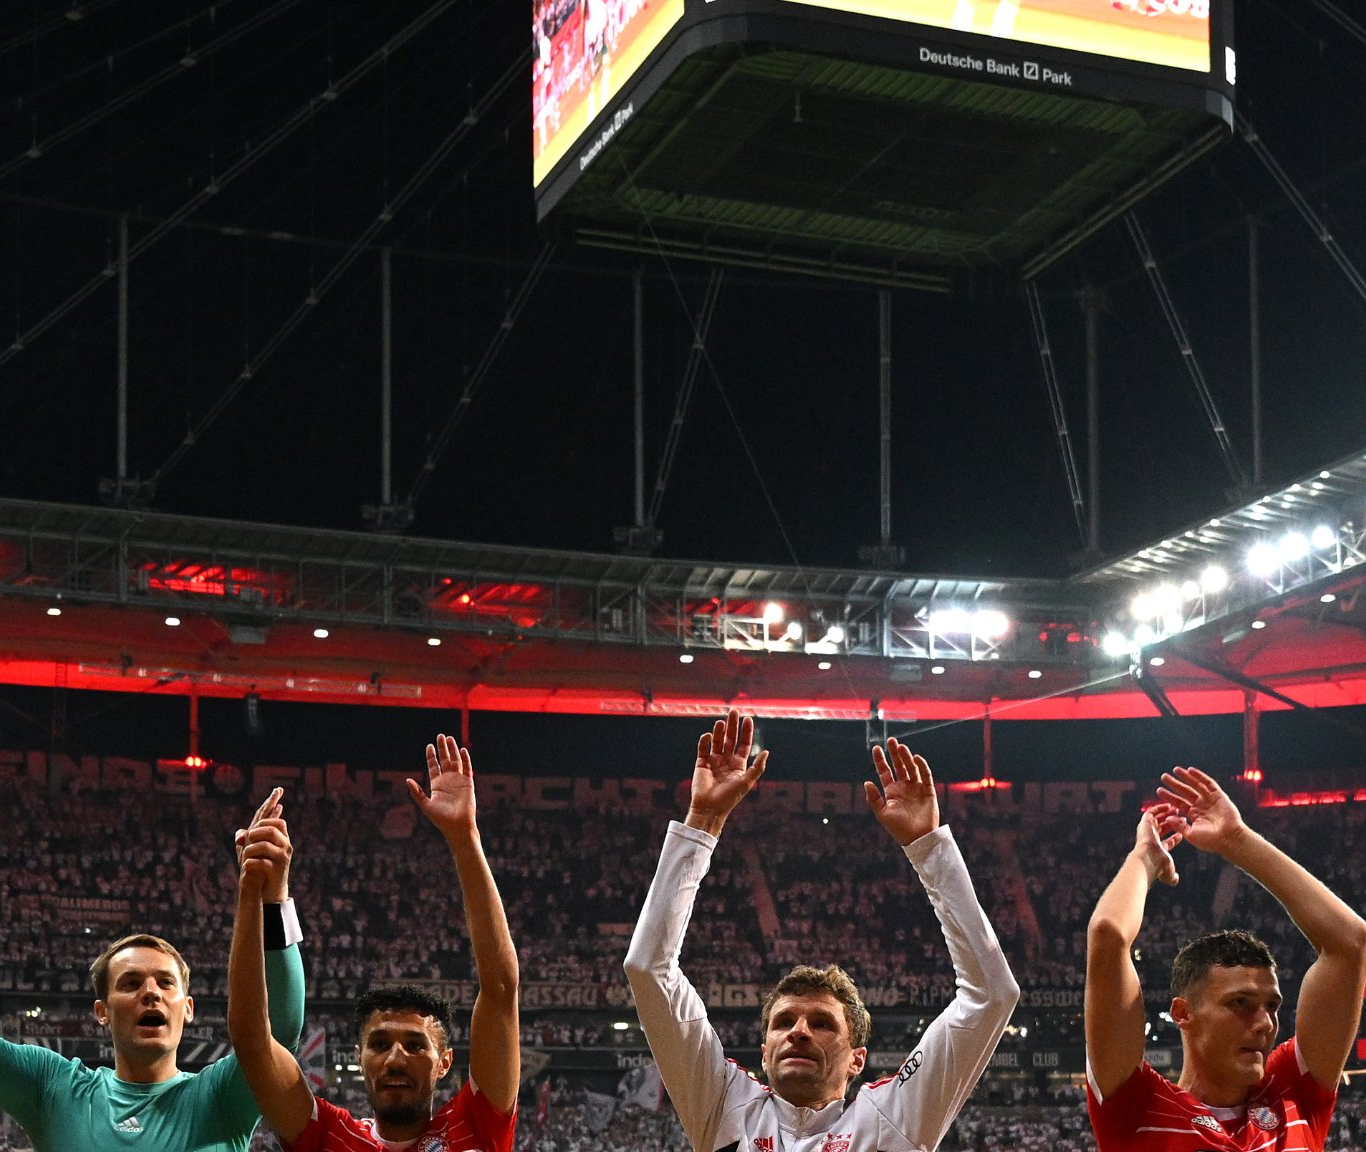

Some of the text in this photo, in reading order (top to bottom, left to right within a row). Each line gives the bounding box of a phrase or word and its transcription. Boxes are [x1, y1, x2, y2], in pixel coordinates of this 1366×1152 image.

[919, 47, 1072, 86] Deutsche Bank Park
[1032, 1052, 1059, 1067] CLUB
[113, 1124, 144, 1133] adidas
[1191, 1117, 1223, 1133] adidas
